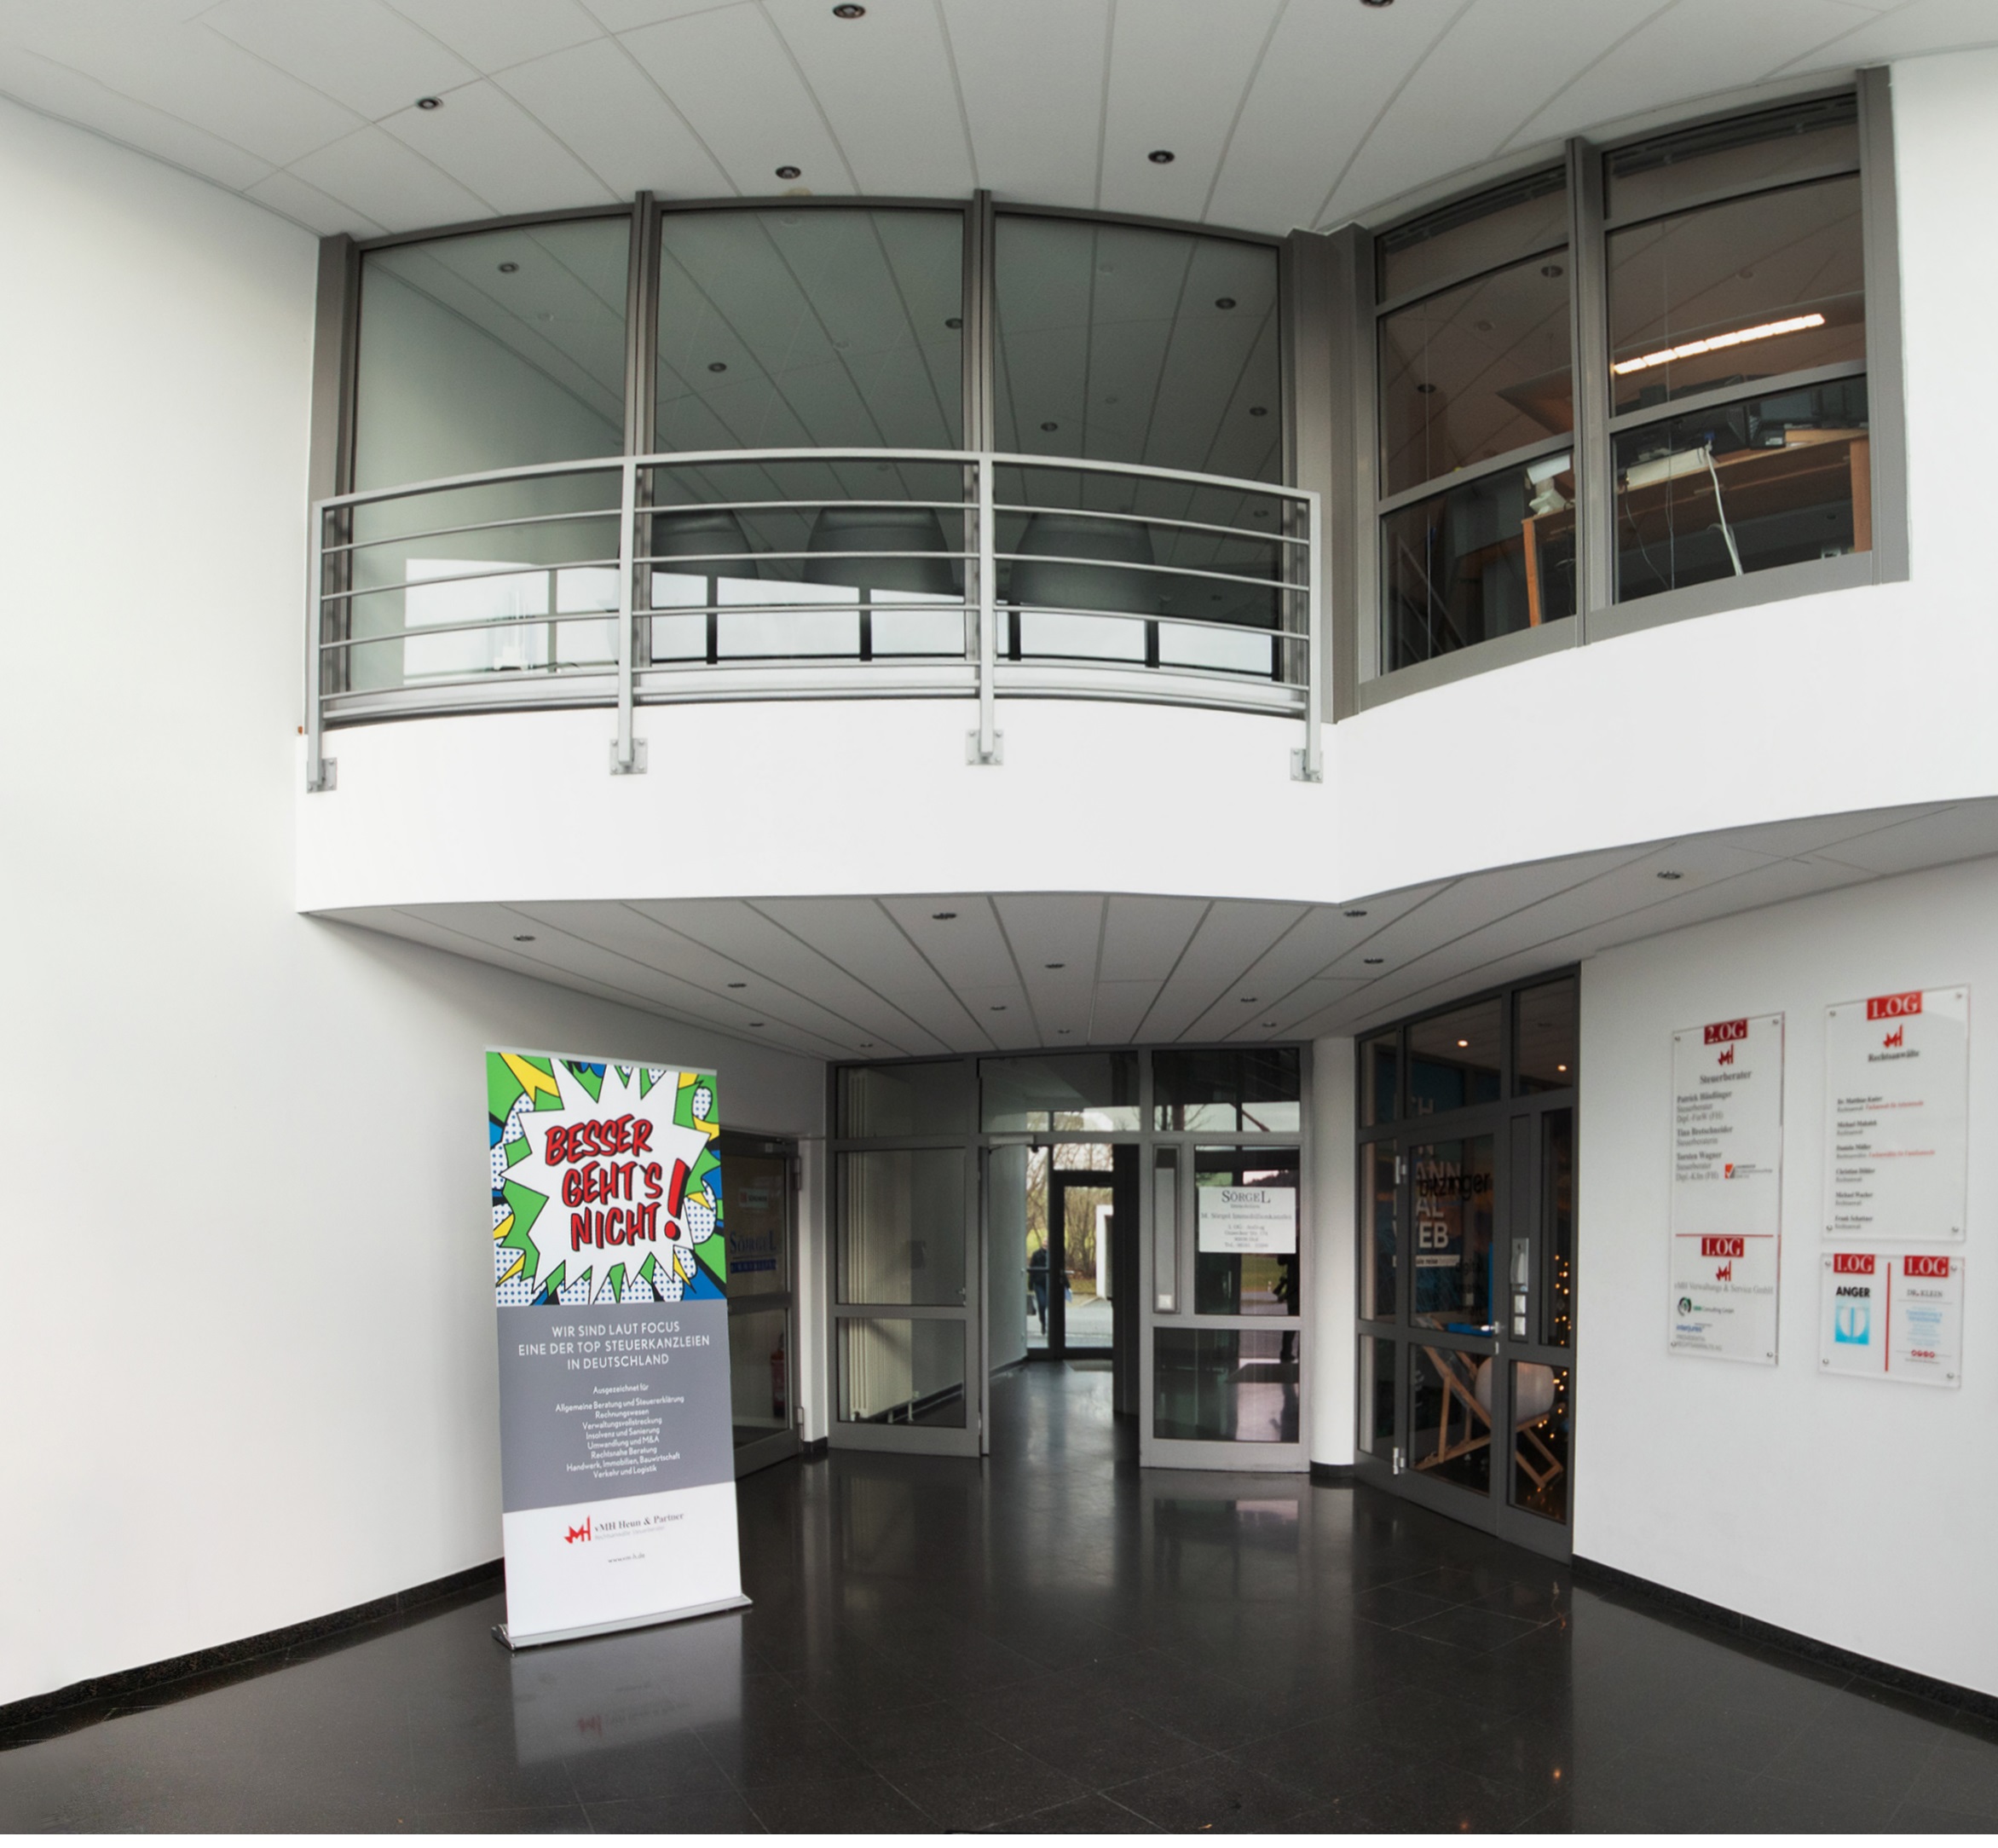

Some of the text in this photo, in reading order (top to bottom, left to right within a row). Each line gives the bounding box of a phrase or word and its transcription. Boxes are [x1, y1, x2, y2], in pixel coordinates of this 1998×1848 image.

[546, 1113, 653, 1167] BESSER
[1221, 1190, 1271, 1204] SÖRGEL
[570, 1202, 661, 1251] NICHT
[1836, 1285, 1870, 1298] ANGER
[551, 1321, 680, 1337] WIR SIND LAUT FOCUS
[518, 1335, 710, 1356] EINE DER TOP STEUERKANZLEIEN
[567, 1354, 669, 1371] IN DEUTSCHLAND
[593, 1384, 638, 1395] Ausgezeichnet
[556, 1395, 684, 1413] Allgemeine Beratung und Steuererklärung
[595, 1409, 650, 1419] Rechnungswesen
[582, 1417, 662, 1430] Verwaltungsvollstreckung
[586, 1427, 660, 1440] Insolvenz und Sanierung
[587, 1435, 660, 1450] Umwandlung und M&A
[591, 1447, 657, 1459] Rechtsnahe Beratung
[640, 1452, 680, 1464] Bauwirtschaft
[593, 1464, 657, 1478] Verkehr und Logistik
[644, 1516, 651, 1526] &
[654, 1513, 684, 1524] Partner
